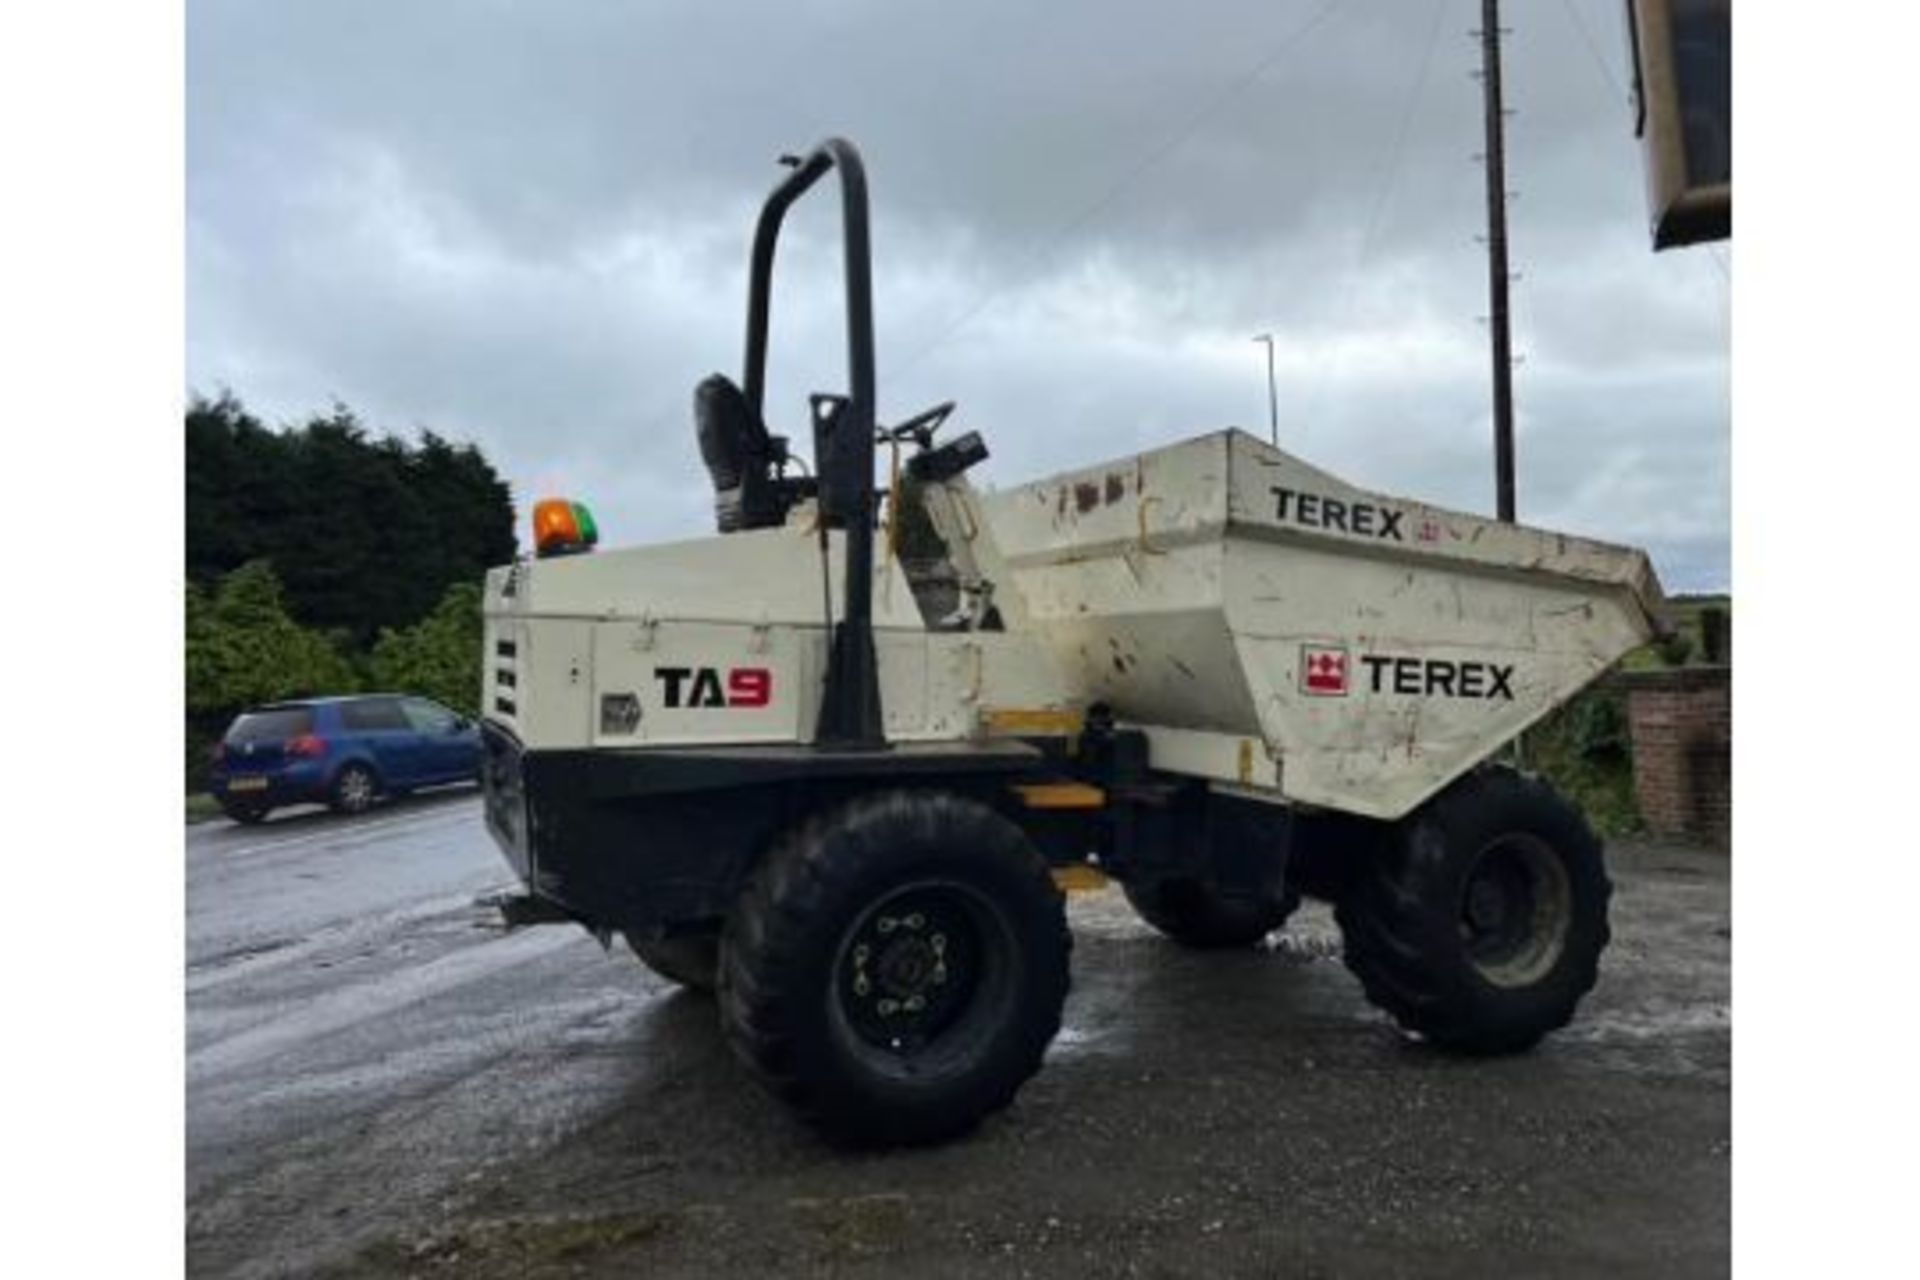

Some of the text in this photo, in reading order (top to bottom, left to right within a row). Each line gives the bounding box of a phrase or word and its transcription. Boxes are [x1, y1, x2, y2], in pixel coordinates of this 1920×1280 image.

[1271, 487, 1404, 541] TEREX
[654, 667, 771, 708] TA9
[1361, 656, 1515, 700] TEREX
